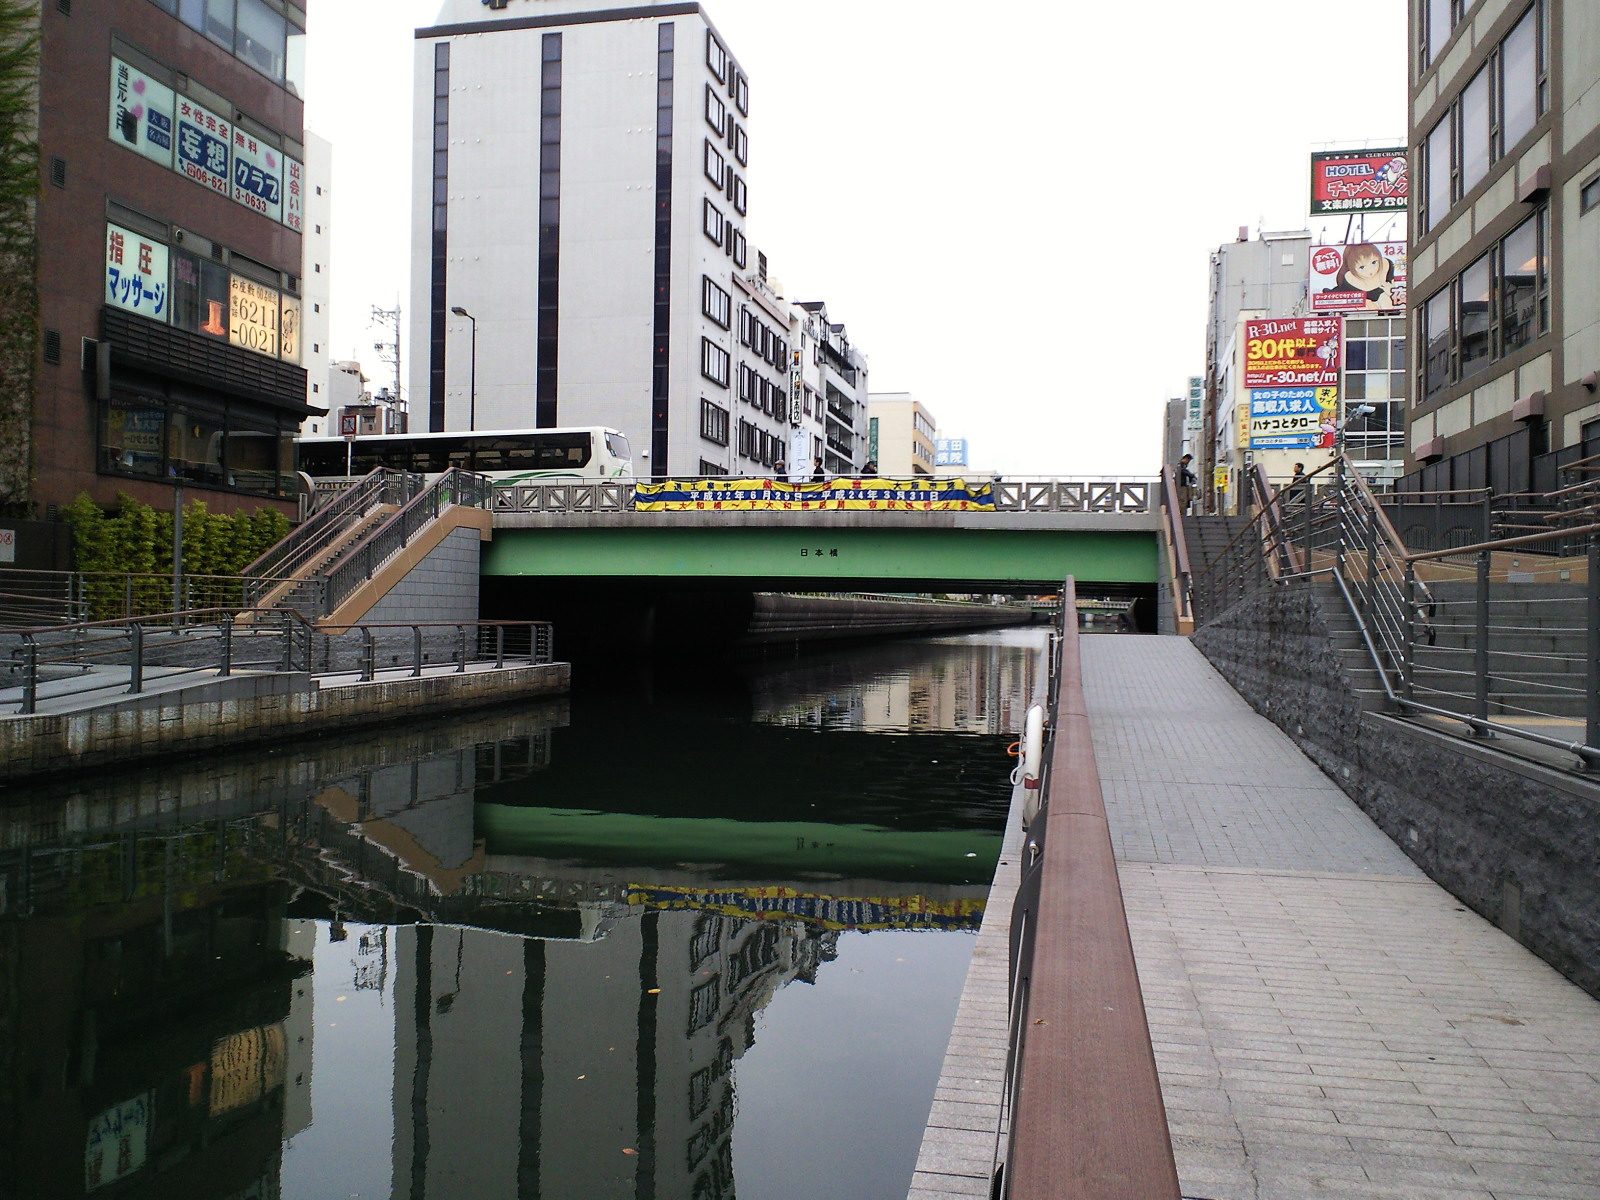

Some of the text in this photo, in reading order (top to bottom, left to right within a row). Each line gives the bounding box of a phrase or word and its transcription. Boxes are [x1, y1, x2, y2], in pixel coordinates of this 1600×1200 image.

[1326, 164, 1374, 177] HOTEL
[110, 231, 152, 275] 指圧
[109, 267, 165, 314] マッサージ
[240, 298, 275, 330] 6211
[1248, 321, 1297, 338] R-30.net
[1253, 390, 1313, 399] 女の子のための
[1253, 400, 1314, 413] 高収入求人
[1253, 418, 1317, 430] ハナコとタロー
[801, 548, 838, 558] 日本橋
